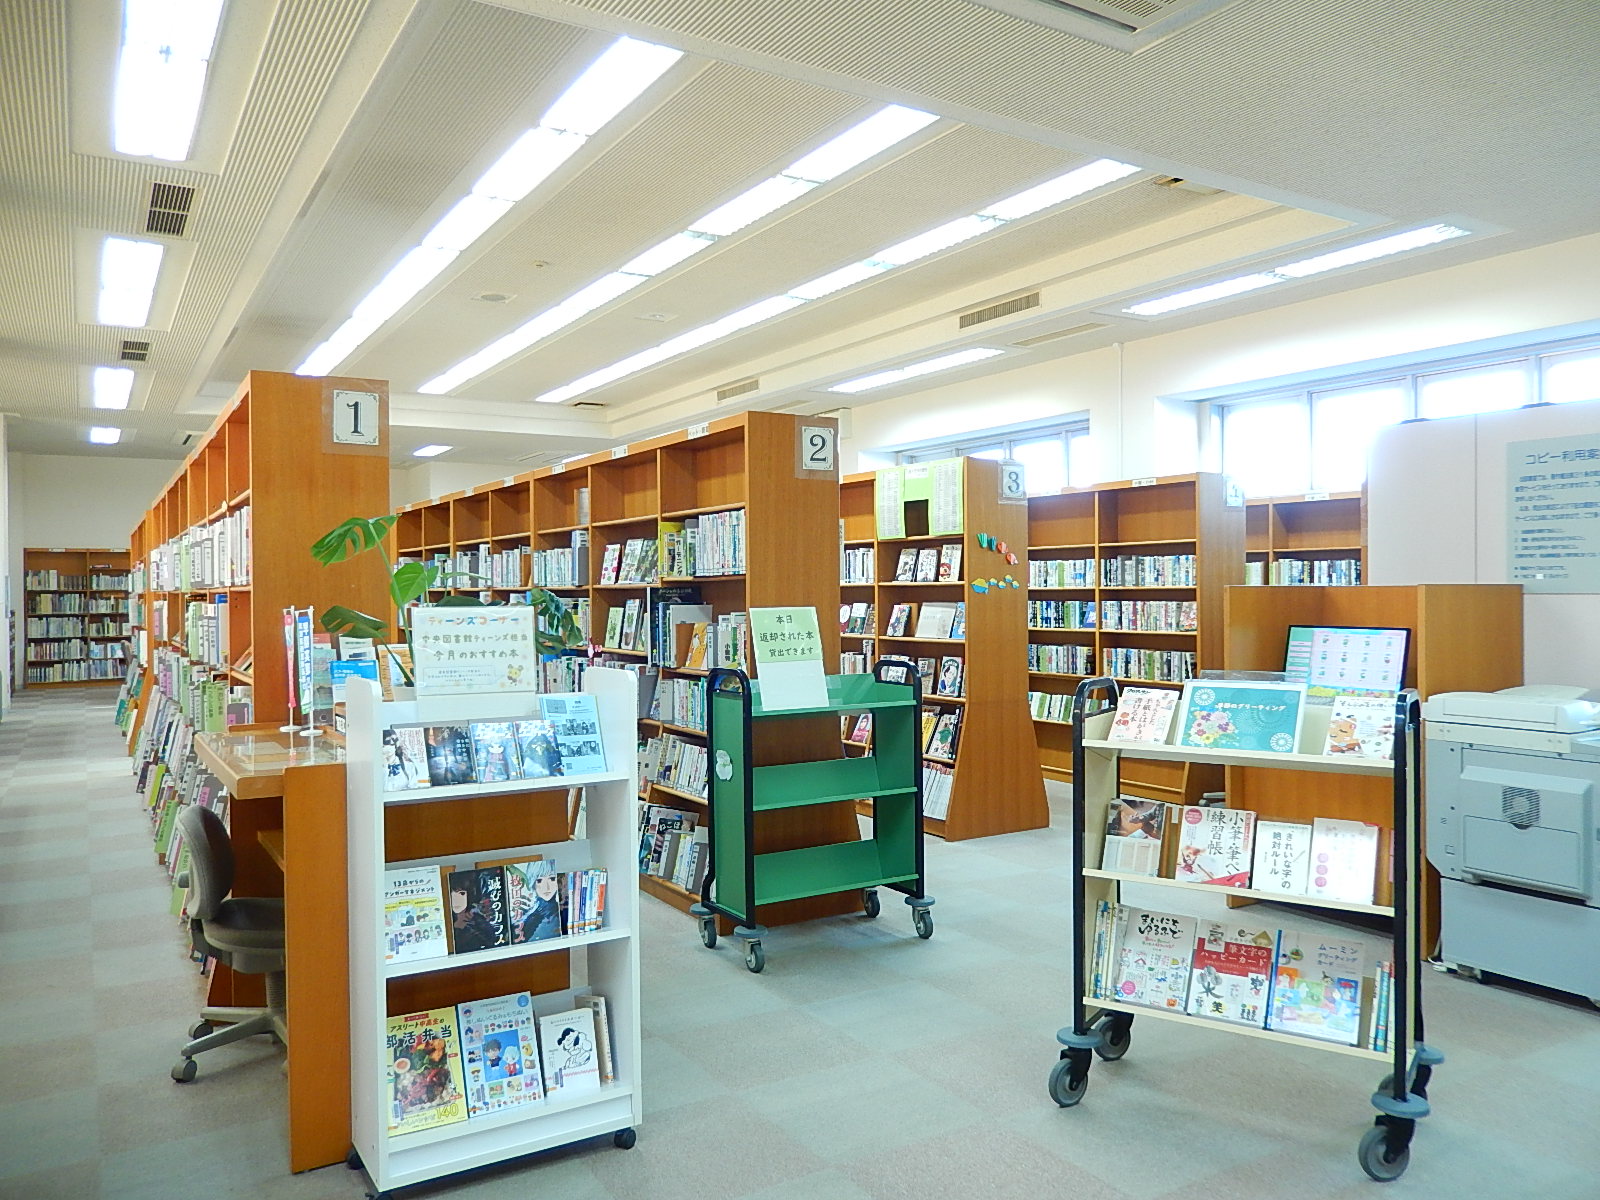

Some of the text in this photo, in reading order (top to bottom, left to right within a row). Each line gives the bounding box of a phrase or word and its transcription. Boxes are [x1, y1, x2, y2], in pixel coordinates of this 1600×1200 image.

[346, 401, 364, 436] 1
[809, 434, 828, 463] 2
[1007, 471, 1020, 493] 3
[428, 616, 520, 626] ティーンズコーナー
[775, 614, 793, 625] 本日
[759, 630, 815, 643] 返却された本
[433, 649, 520, 661] 今月のおすすめ本
[768, 646, 814, 658] 貸出できます
[1207, 810, 1226, 856] 練習帳
[1269, 831, 1282, 875] 絶対ルール
[386, 1024, 452, 1049] 部活弁当
